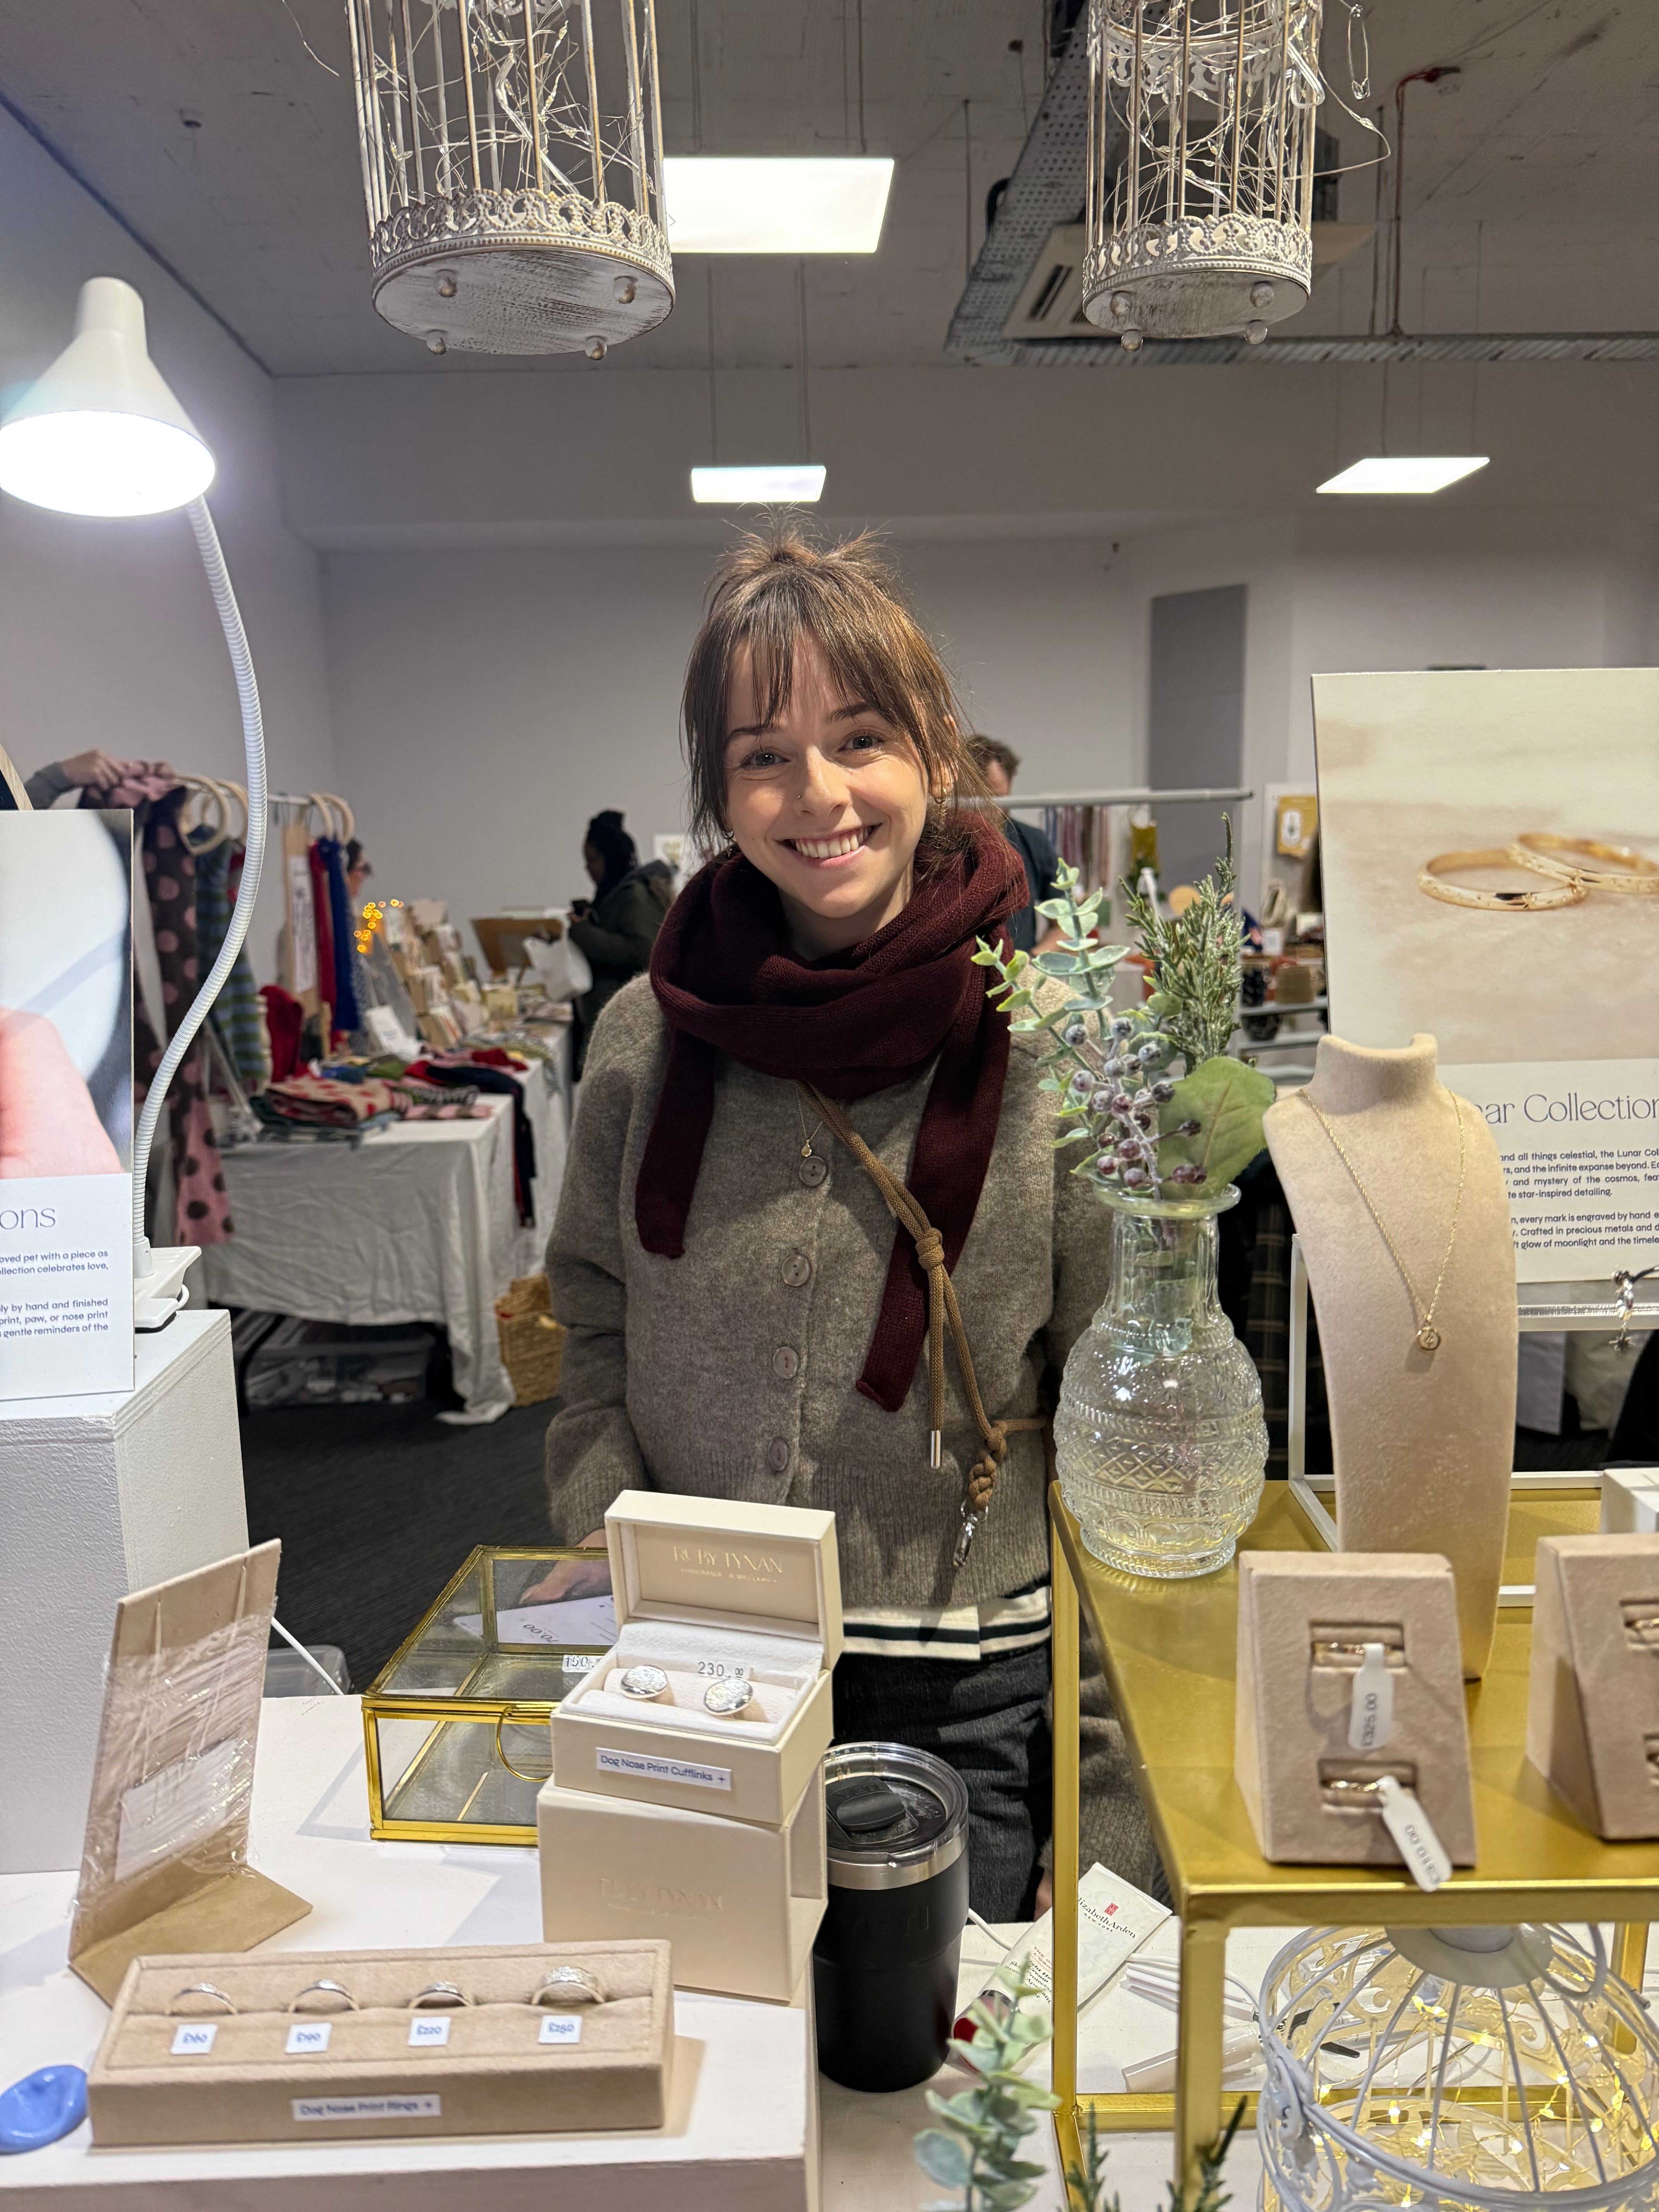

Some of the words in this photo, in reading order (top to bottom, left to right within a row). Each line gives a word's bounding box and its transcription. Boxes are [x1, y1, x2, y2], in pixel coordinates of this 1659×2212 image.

[1518, 1152, 1528, 1161] all
[1531, 1152, 1557, 1161] things
[1560, 1150, 1597, 1159] celestial,
[1600, 1150, 1614, 1158] the
[1644, 1148, 1659, 1156] Col
[1514, 1165, 1530, 1173] and
[1548, 1163, 1577, 1173] infinite
[1579, 1163, 1614, 1173] expanse
[1616, 1161, 1649, 1171] beyond.
[1513, 1178, 1529, 1186] and
[1534, 1177, 1568, 1187] mystery
[1573, 1175, 1582, 1184] of
[1587, 1175, 1601, 1183] the
[1605, 1174, 1640, 1183] cosmos,
[1518, 1188, 1572, 1199] star-inspired
[1574, 1187, 1612, 1197] detailing.
[0, 1208, 56, 1230] ons
[1520, 1216, 1543, 1225] every
[1544, 1214, 1567, 1223] mark
[1568, 1213, 1575, 1222] is
[1577, 1212, 1616, 1223] engraved
[1618, 1211, 1628, 1222] by
[1630, 1211, 1650, 1219] hand
[1520, 1227, 1554, 1236] Crafted
[1556, 1227, 1563, 1235] in
[1566, 1225, 1602, 1237] precious
[1605, 1224, 1633, 1233] metals
[1636, 1223, 1652, 1232] and
[1521, 1240, 1541, 1250] glow
[1544, 1239, 1552, 1247] of
[1554, 1238, 1597, 1249] moonlight
[1599, 1237, 1615, 1246] and
[1617, 1237, 1631, 1245] the
[24, 1254, 38, 1264] pet
[41, 1252, 60, 1261] with
[71, 1250, 96, 1261] piece
[0, 1266, 35, 1275] llection
[37, 1263, 86, 1273] celebrates
[88, 1262, 108, 1271] love,
[0, 1304, 9, 1314] ly
[12, 1304, 22, 1313] by
[26, 1301, 49, 1311] hand
[52, 1300, 69, 1309] and
[72, 1298, 108, 1308] finished
[25, 1316, 47, 1326] paw,
[62, 1313, 84, 1321] nose
[88, 1310, 108, 1321] print
[3, 1328, 33, 1339] gentle
[34, 1325, 80, 1335] reminders
[82, 1323, 92, 1332] of
[94, 1322, 108, 1331] the
[673, 1546, 716, 1566] RUBY
[725, 1553, 782, 1573] TYNAN
[566, 1656, 602, 1667] 150.
[601, 1755, 620, 1767] Dog
[621, 1759, 645, 1769] Nose
[647, 1763, 669, 1774] Print
[670, 1766, 713, 1781] Cufflinks
